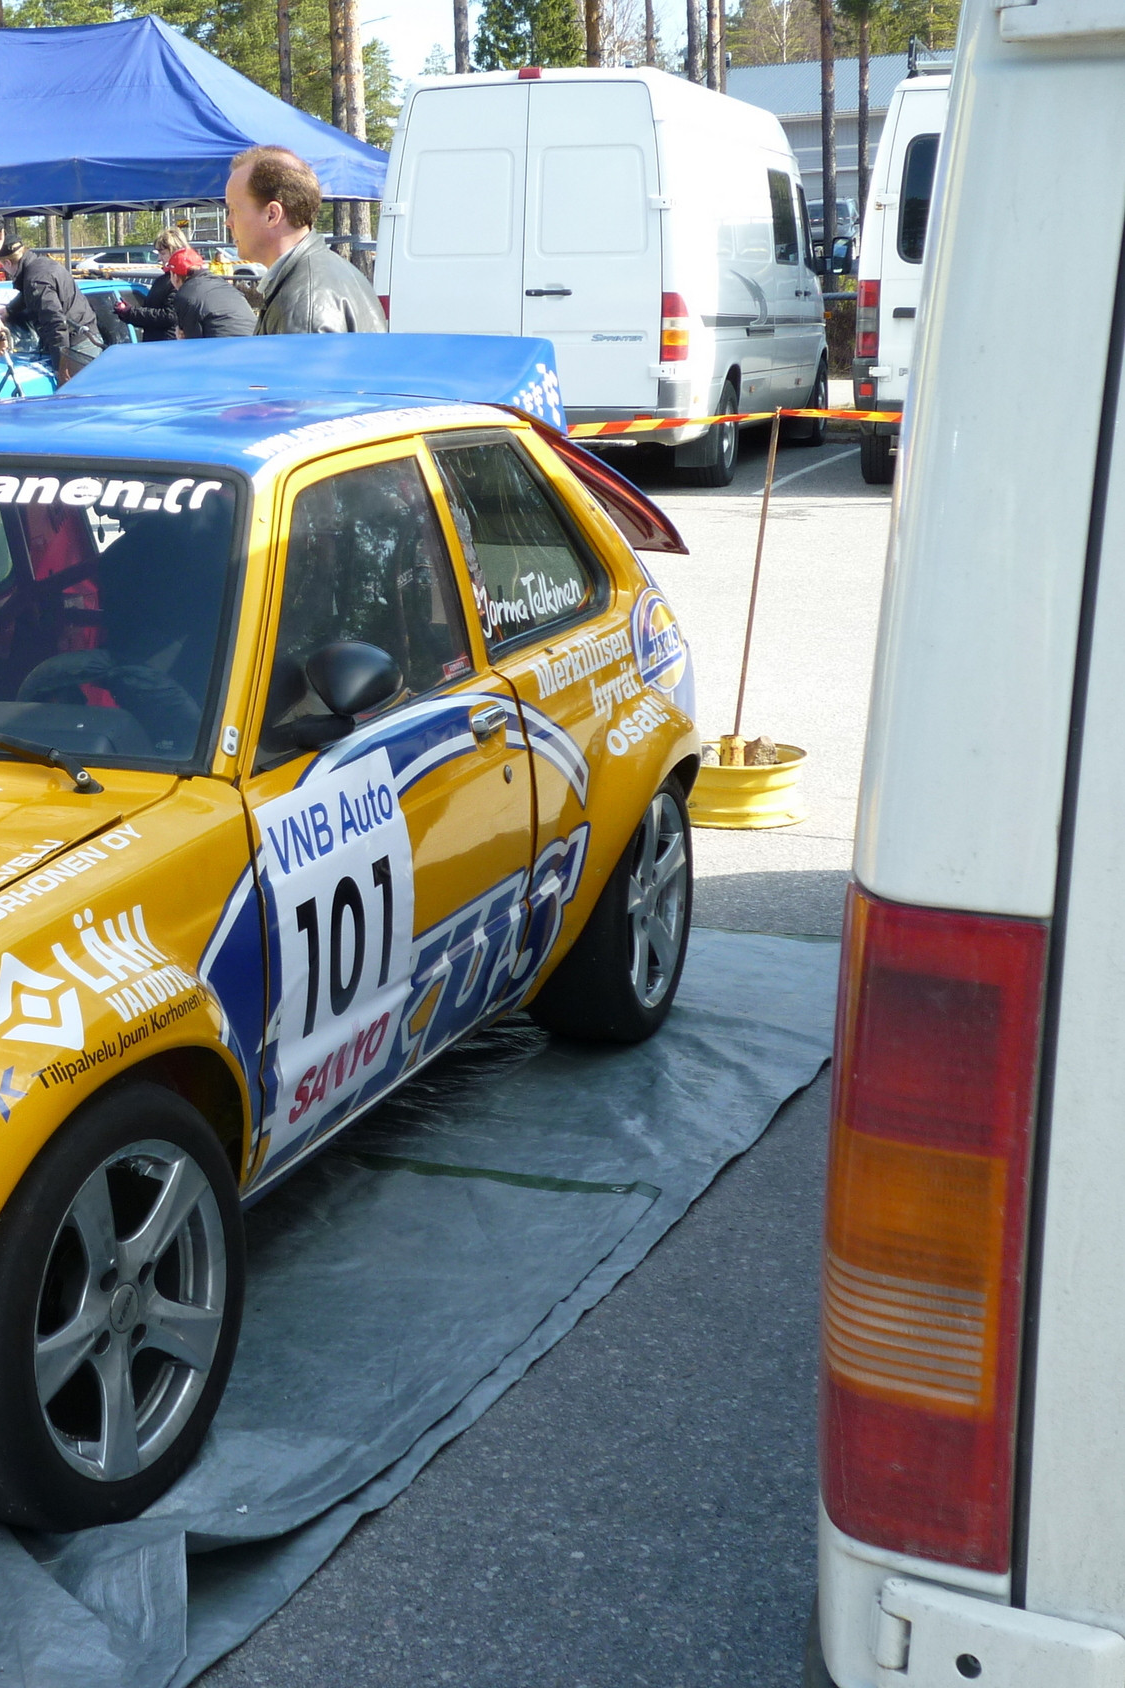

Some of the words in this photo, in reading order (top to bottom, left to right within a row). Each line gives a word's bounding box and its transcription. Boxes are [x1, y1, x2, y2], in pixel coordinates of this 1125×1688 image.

[480, 585, 530, 639] Jorma
[520, 571, 582, 618] Telkinen
[529, 629, 632, 700] Merkillisen
[590, 662, 641, 720] hyvät
[606, 695, 671, 756] osat!
[101, 823, 143, 850] OY
[268, 802, 334, 875] VNB
[338, 779, 394, 843] Auto
[51, 904, 169, 994] LÄHI
[295, 855, 395, 1039] 101
[31, 1040, 116, 1089] Tilipalvelu
[118, 1019, 149, 1057] Jouni
[151, 995, 201, 1034] Korhonen
